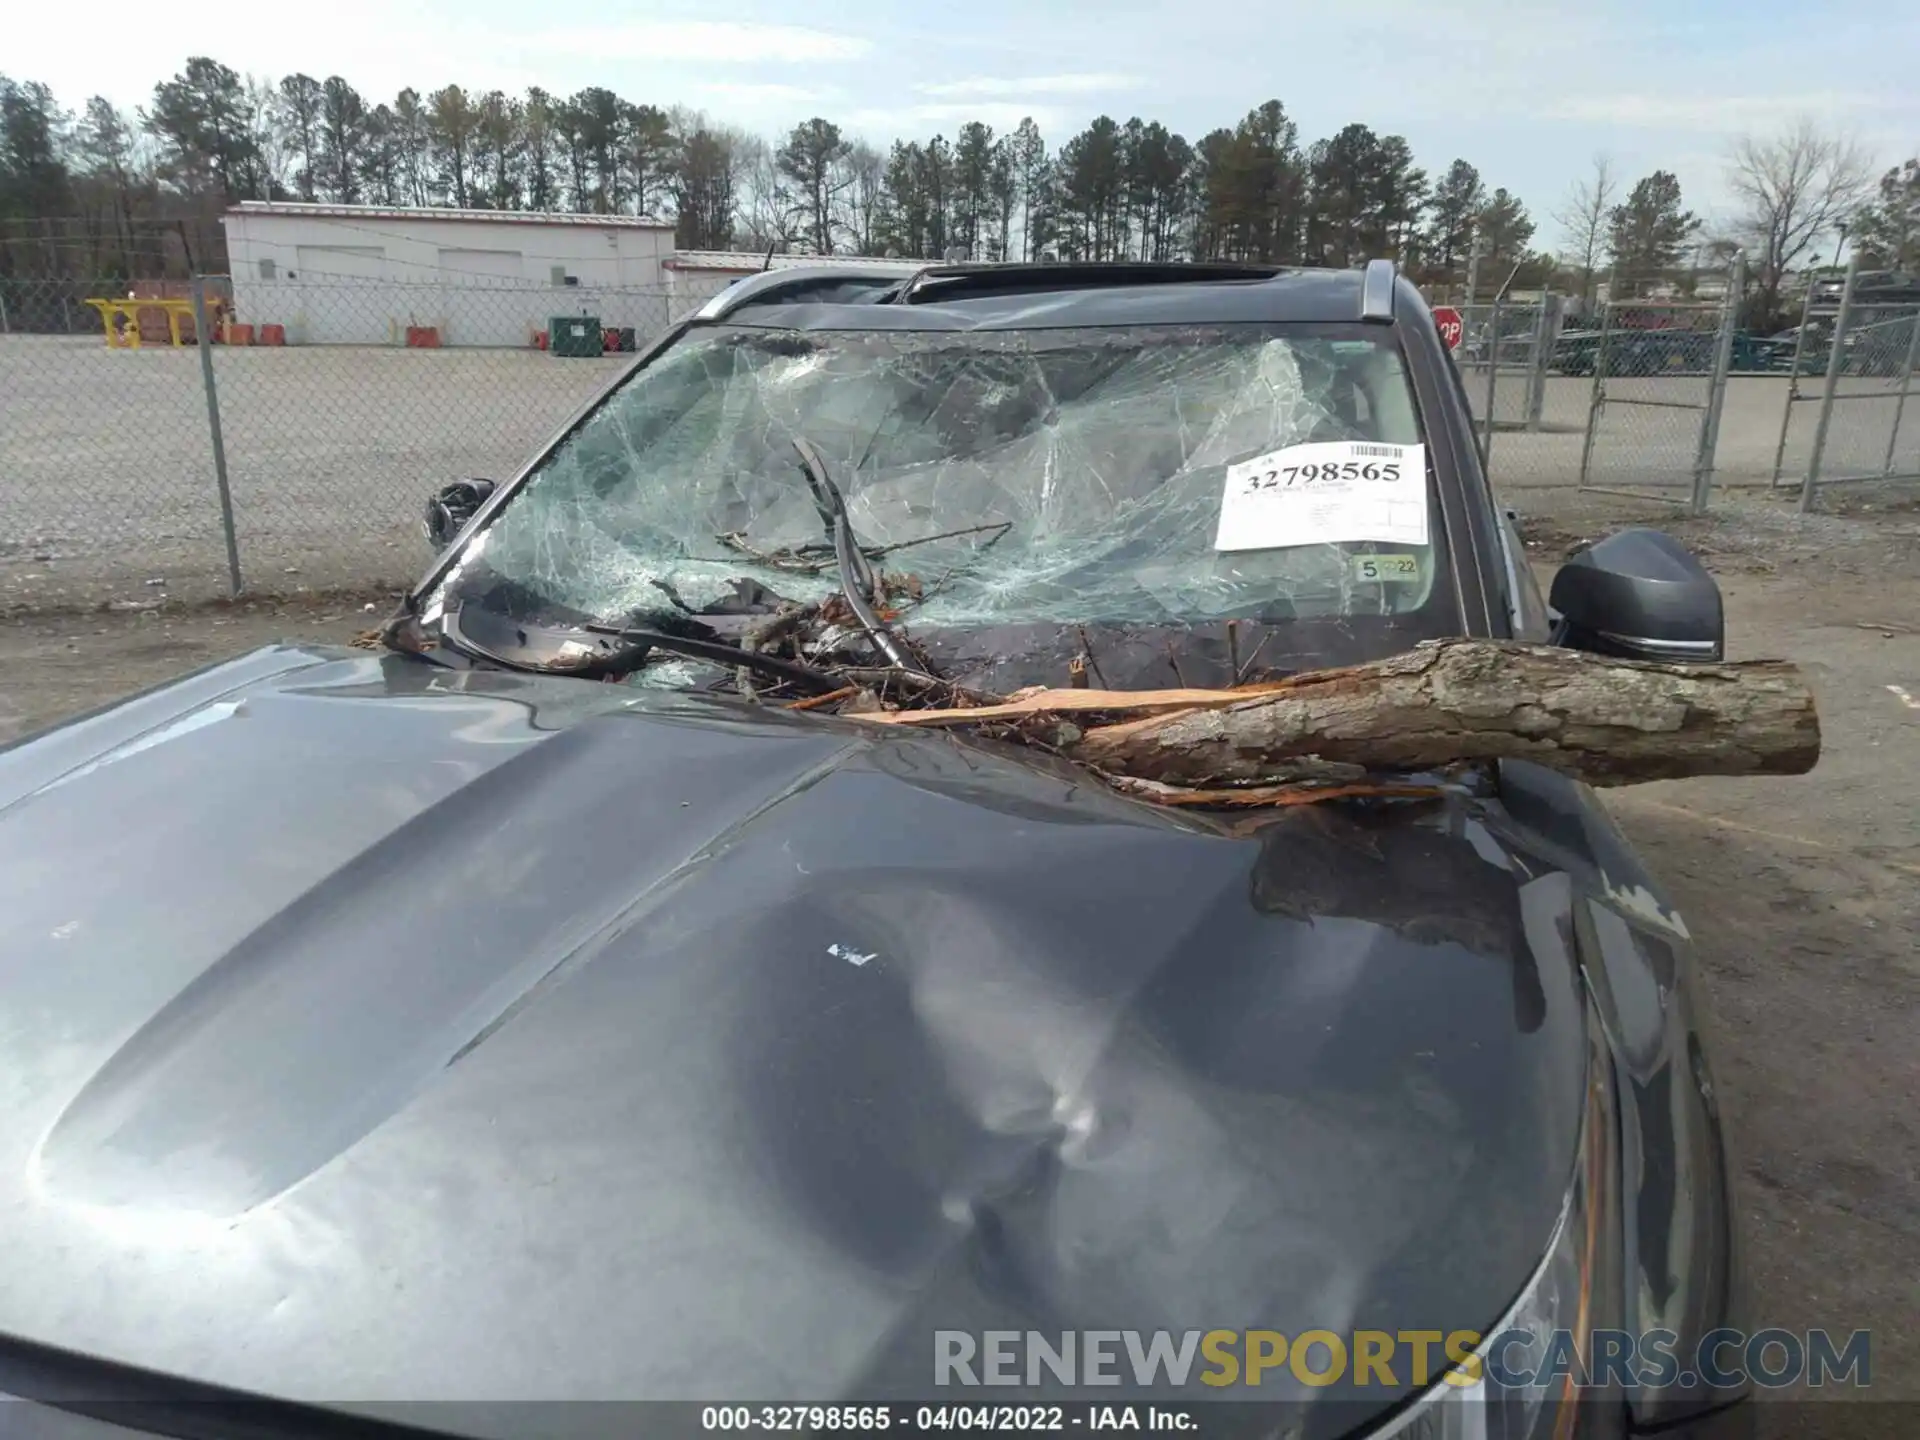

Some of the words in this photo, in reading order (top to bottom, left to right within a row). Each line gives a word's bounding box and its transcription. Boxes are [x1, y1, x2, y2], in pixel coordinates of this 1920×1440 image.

[1244, 462, 1401, 494] 32798565
[1363, 562, 1378, 577] 5
[1398, 560, 1416, 572] 22
